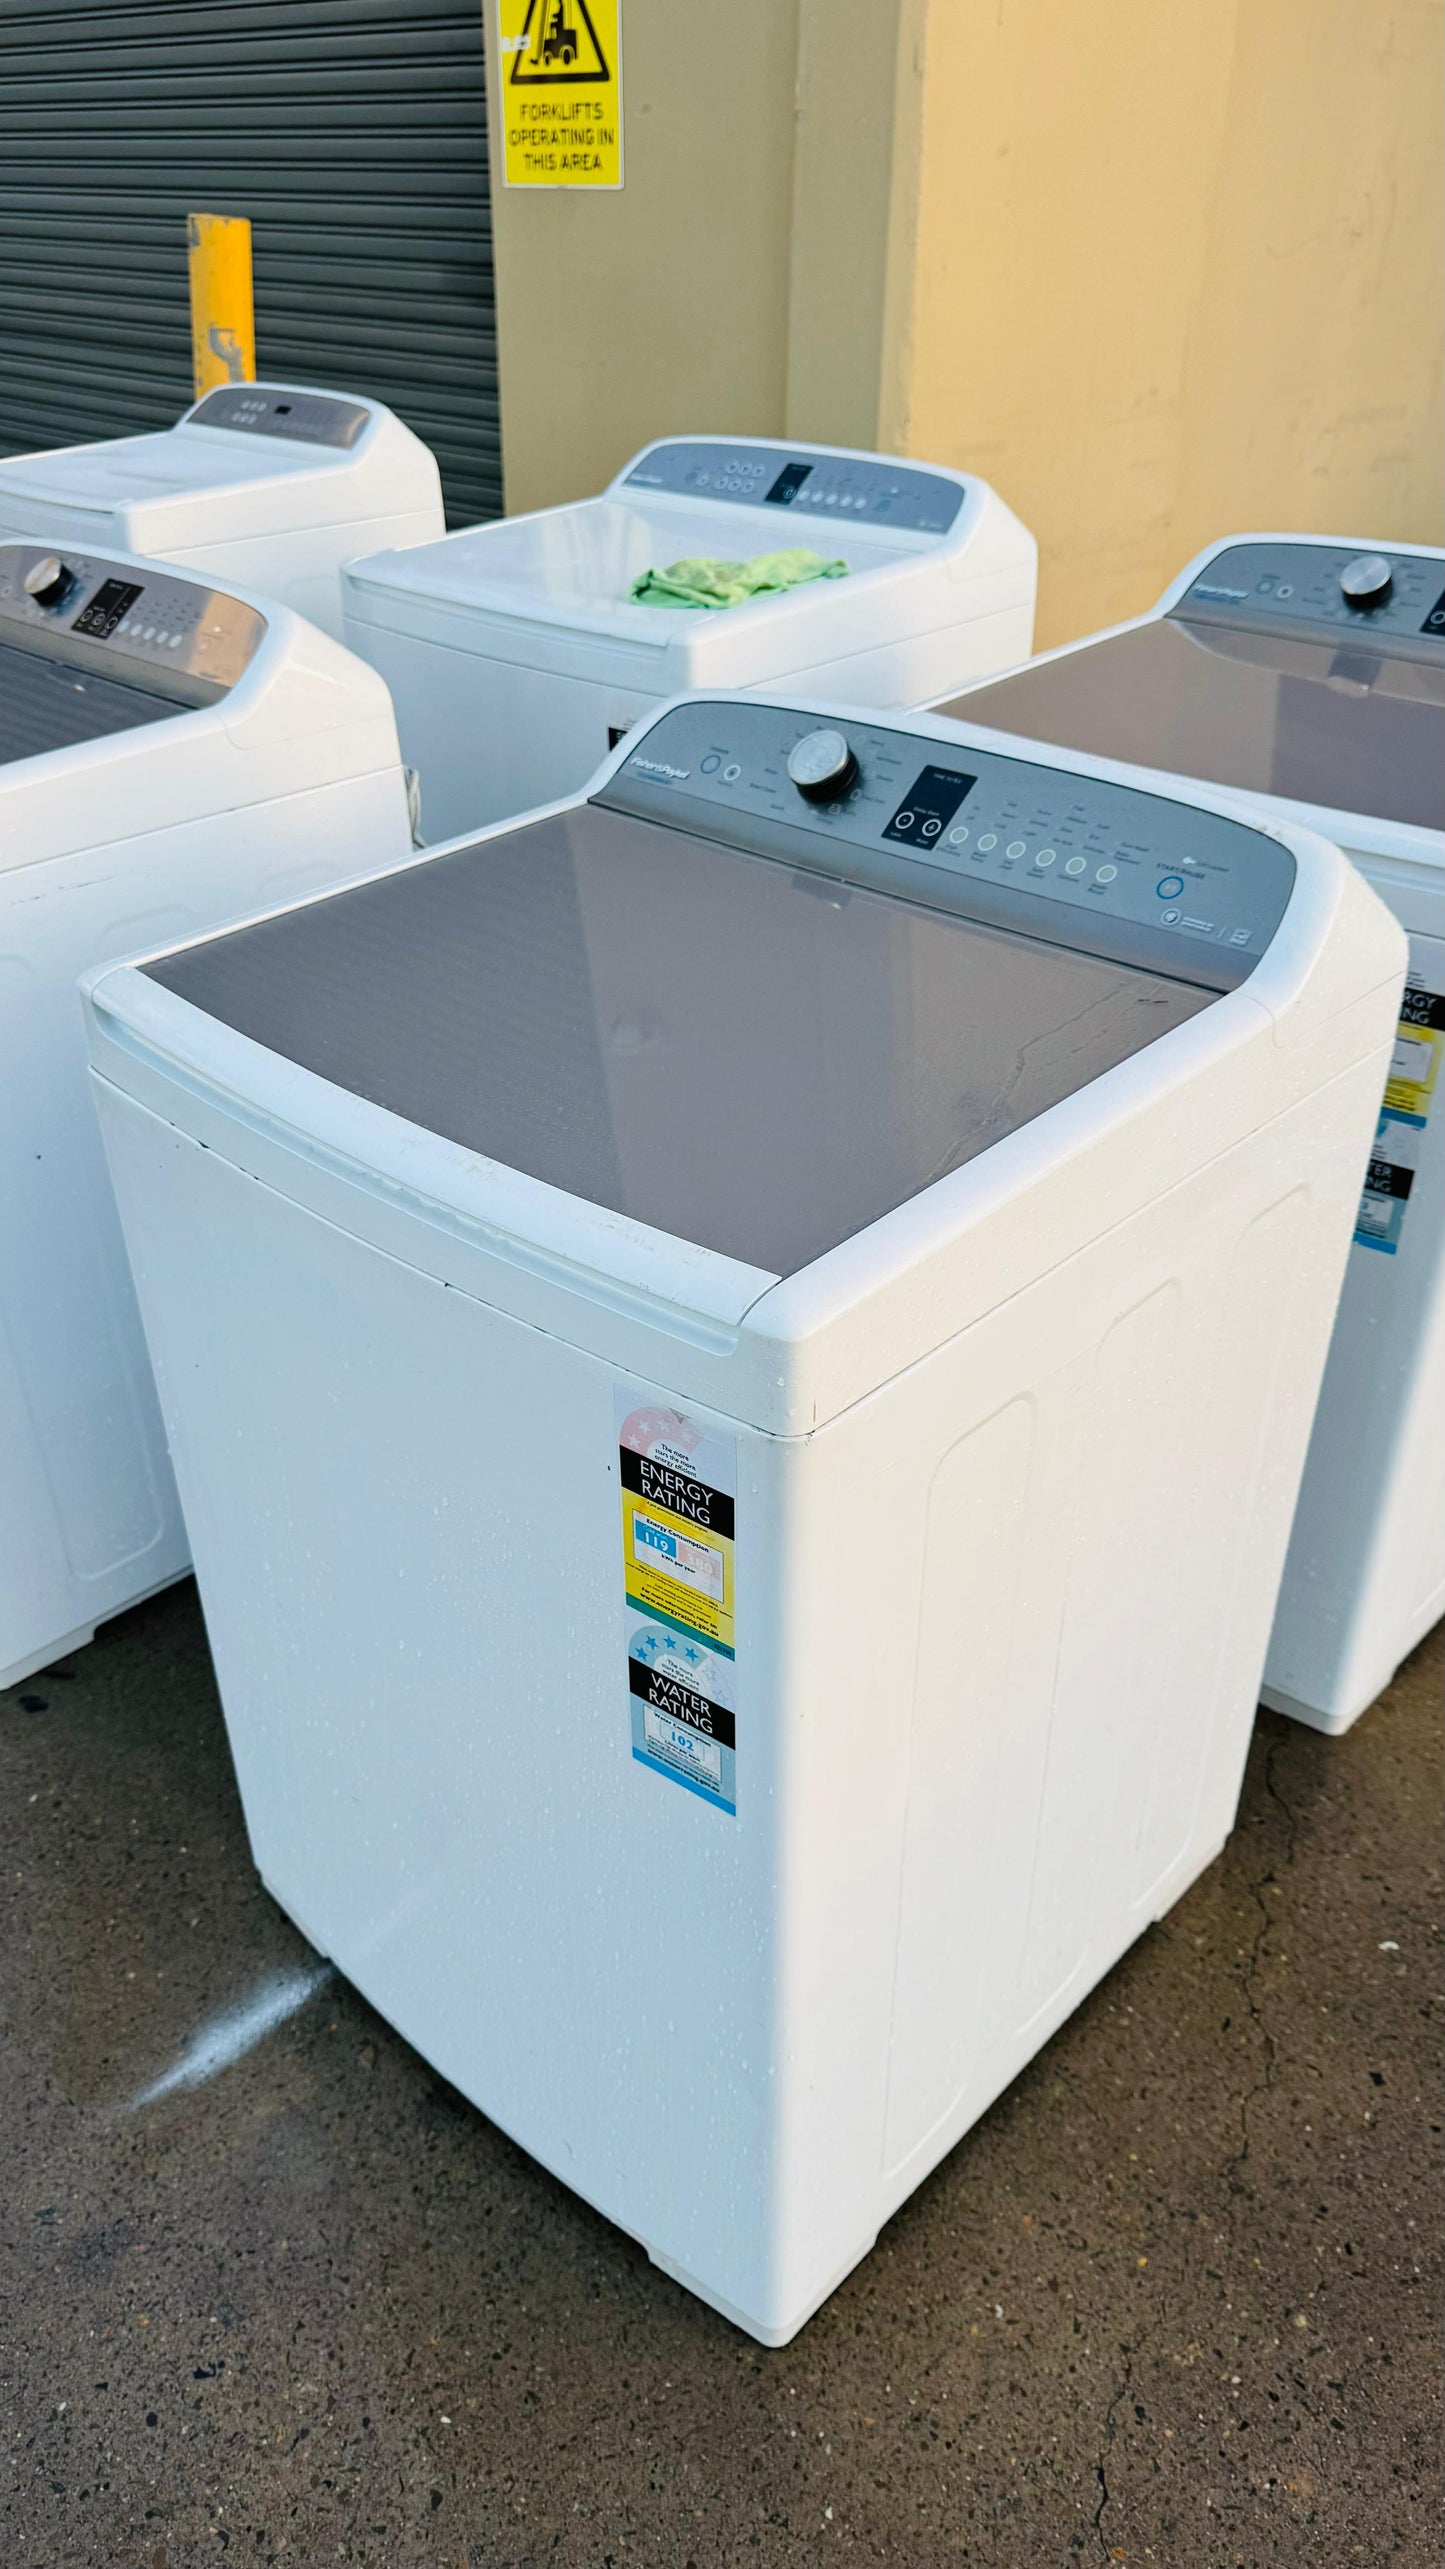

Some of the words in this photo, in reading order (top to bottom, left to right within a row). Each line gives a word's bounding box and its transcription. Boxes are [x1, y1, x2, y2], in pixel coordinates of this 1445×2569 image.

[520, 102, 604, 120] FORKLIFTS
[510, 129, 596, 146] OPERATING
[600, 127, 615, 144] IN
[525, 153, 557, 170] THIS
[561, 153, 603, 170] AREA
[655, 1448, 669, 1458] stars
[670, 1454, 679, 1462] the
[680, 1460, 696, 1471] more
[655, 1455, 674, 1468] energy
[661, 1443, 672, 1453] The
[674, 1451, 689, 1461] more
[640, 1460, 714, 1506] ENERGY
[642, 1479, 710, 1524] RATING
[645, 1532, 669, 1552] 119
[646, 1518, 668, 1533] Energy
[668, 1527, 709, 1553] Consumption
[640, 1593, 719, 1636] www.energyrating.gov.au
[651, 1672, 712, 1718] WATER
[649, 1687, 713, 1734] RATING
[654, 1712, 672, 1724] Water
[672, 1731, 694, 1752] 102
